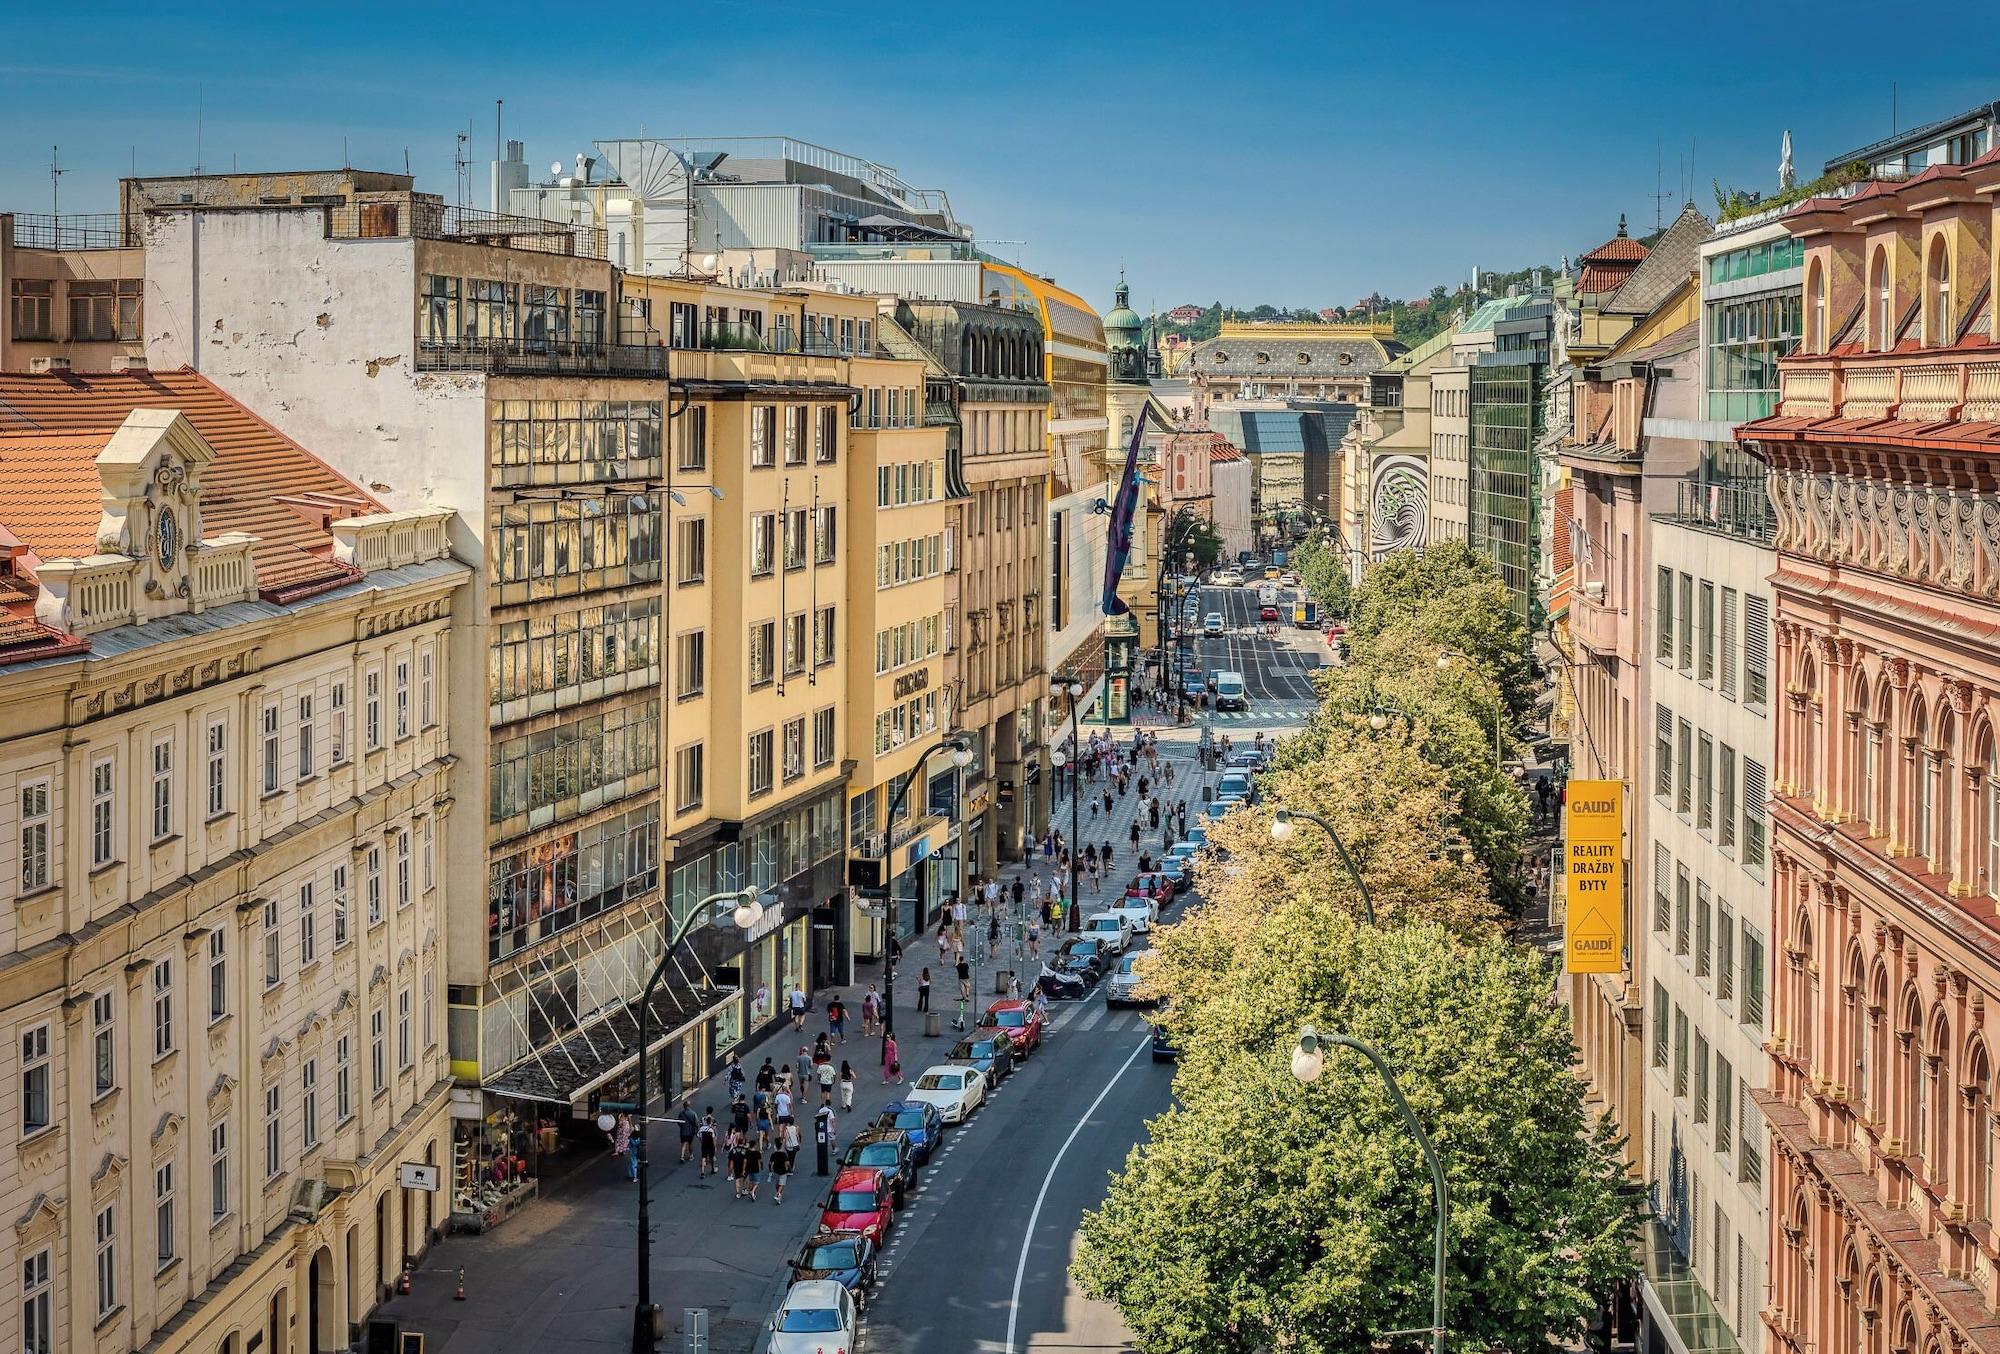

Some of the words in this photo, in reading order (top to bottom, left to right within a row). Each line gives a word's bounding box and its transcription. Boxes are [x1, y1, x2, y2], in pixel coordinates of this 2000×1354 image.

[1571, 798, 1616, 813] GAUDÍ
[1573, 845, 1615, 856] REALITY
[1573, 859, 1615, 873] DRAŽBY
[1580, 879, 1607, 890] BYTY
[1574, 937, 1613, 950] GAUDÍ
